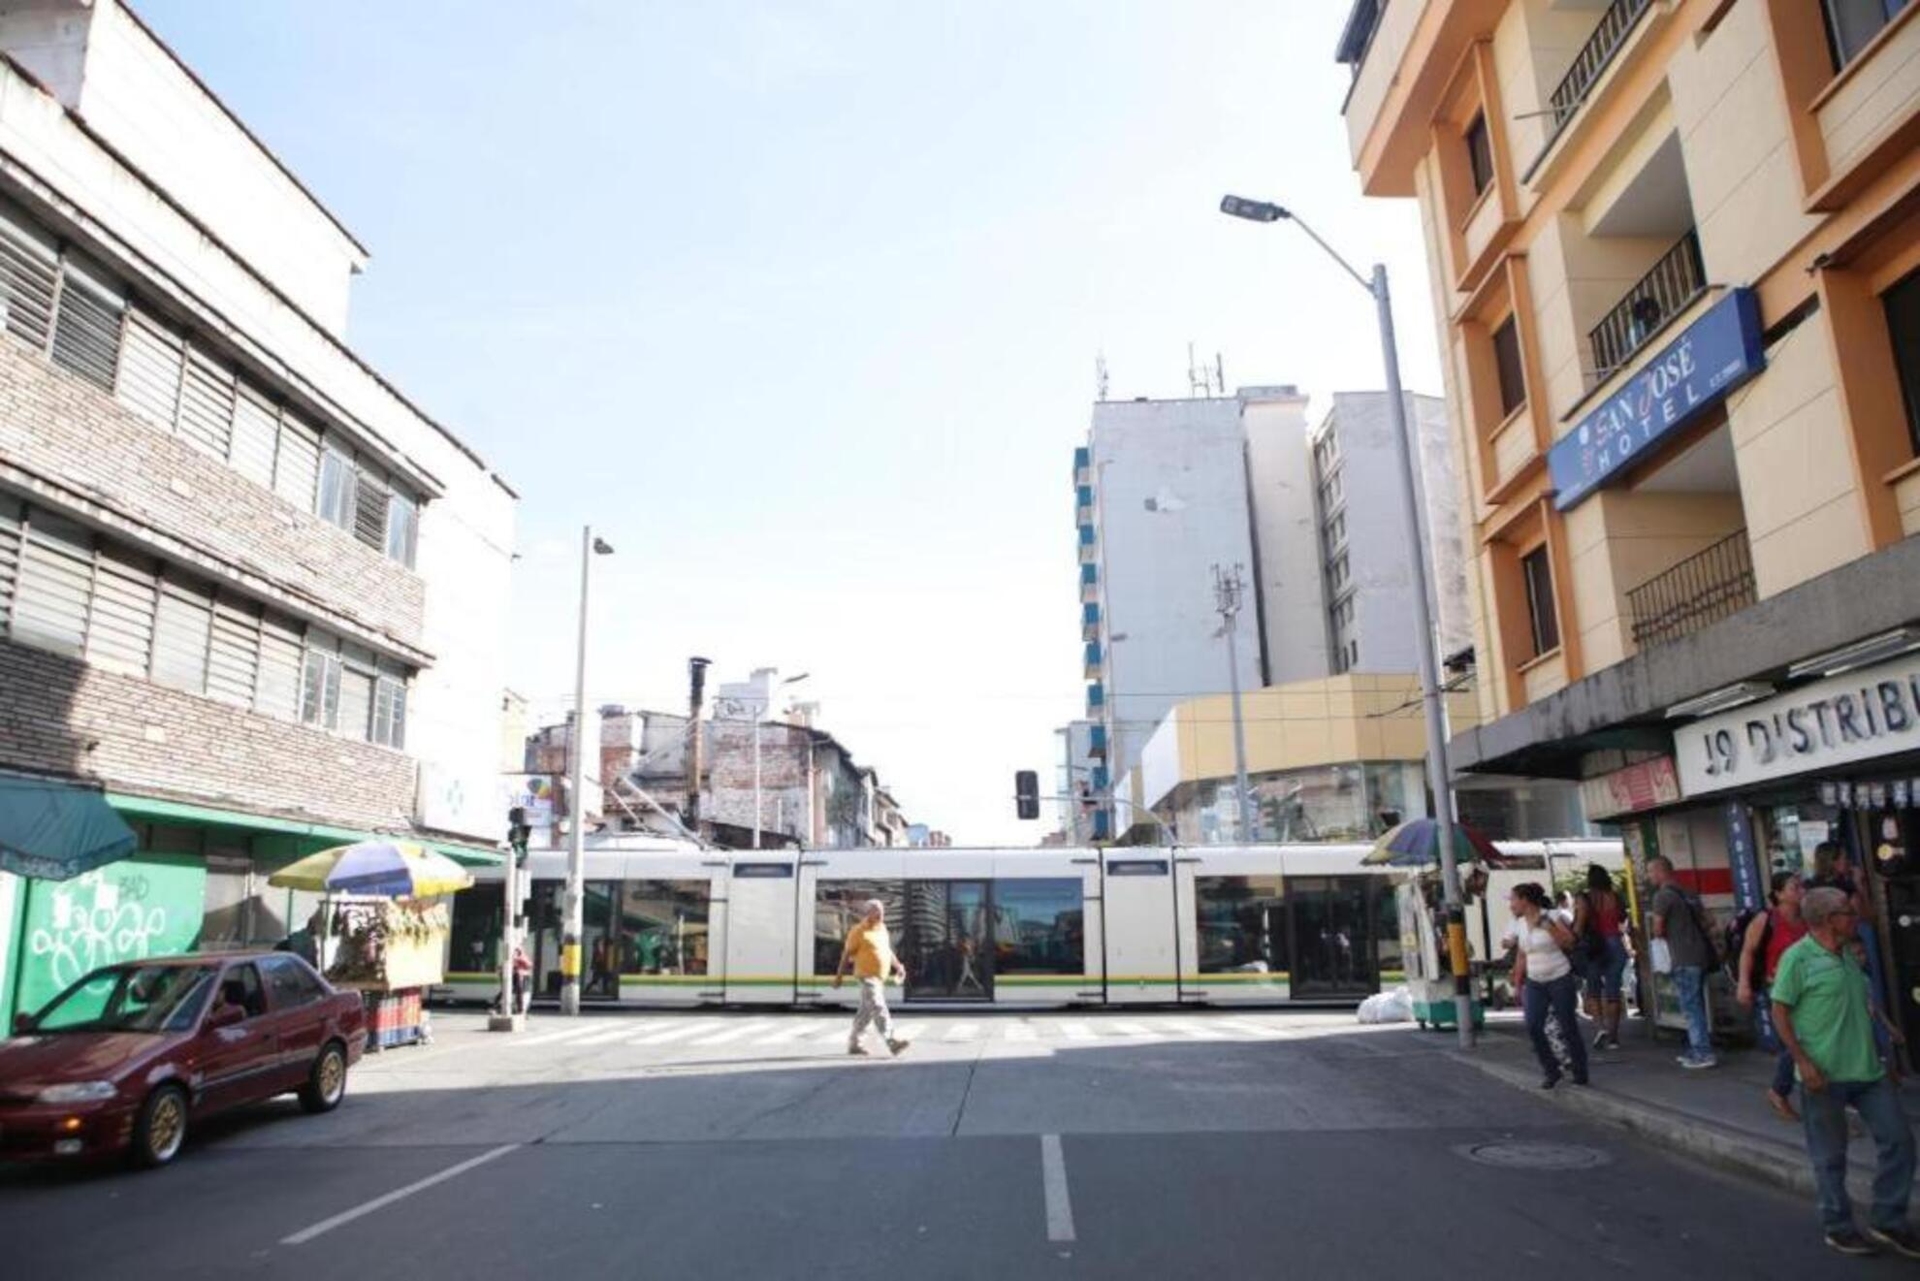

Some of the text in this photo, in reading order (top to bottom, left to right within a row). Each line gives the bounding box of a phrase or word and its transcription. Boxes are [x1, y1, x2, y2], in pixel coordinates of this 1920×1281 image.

[1596, 391, 1635, 447] SAN
[1638, 334, 1697, 417] JOSÉ
[1597, 383, 1700, 472] HOTEL
